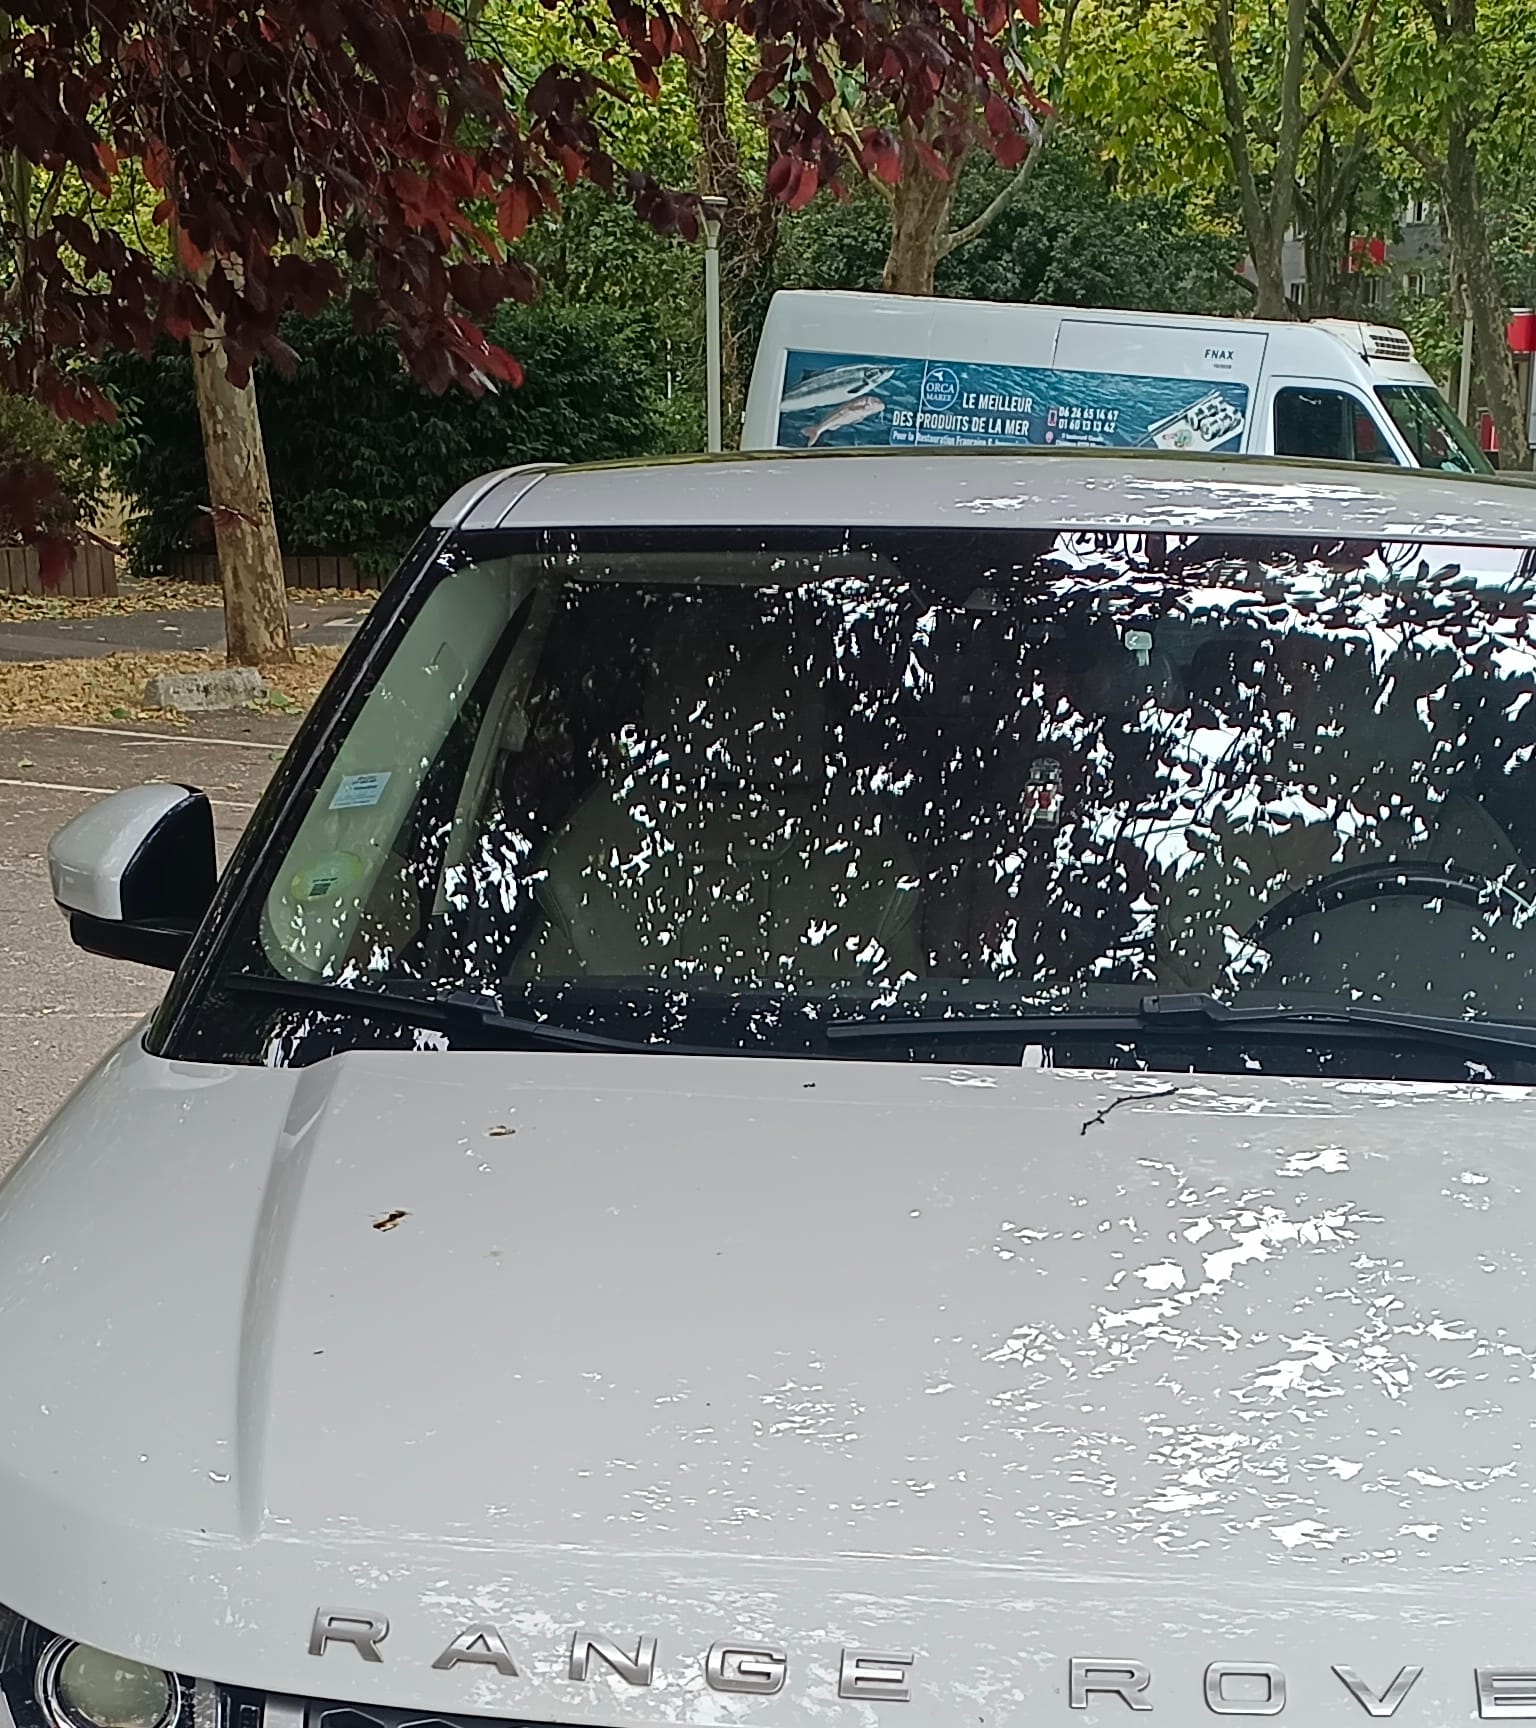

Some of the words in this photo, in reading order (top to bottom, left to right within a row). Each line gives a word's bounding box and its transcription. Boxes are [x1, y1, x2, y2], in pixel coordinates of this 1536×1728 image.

[926, 382, 955, 394] ORCA
[962, 392, 976, 409] LE
[978, 393, 1033, 413] MEILLEUR
[1059, 406, 1070, 417] 06
[1071, 407, 1082, 418] 26
[892, 410, 914, 427] DES
[917, 412, 969, 432] PRODUITS
[971, 416, 986, 433] DE
[987, 417, 1002, 434] LA
[1004, 419, 1030, 436] MER
[1058, 418, 1068, 429] 01
[1082, 420, 1091, 431] 13
[306, 1604, 916, 1703] RANGE
